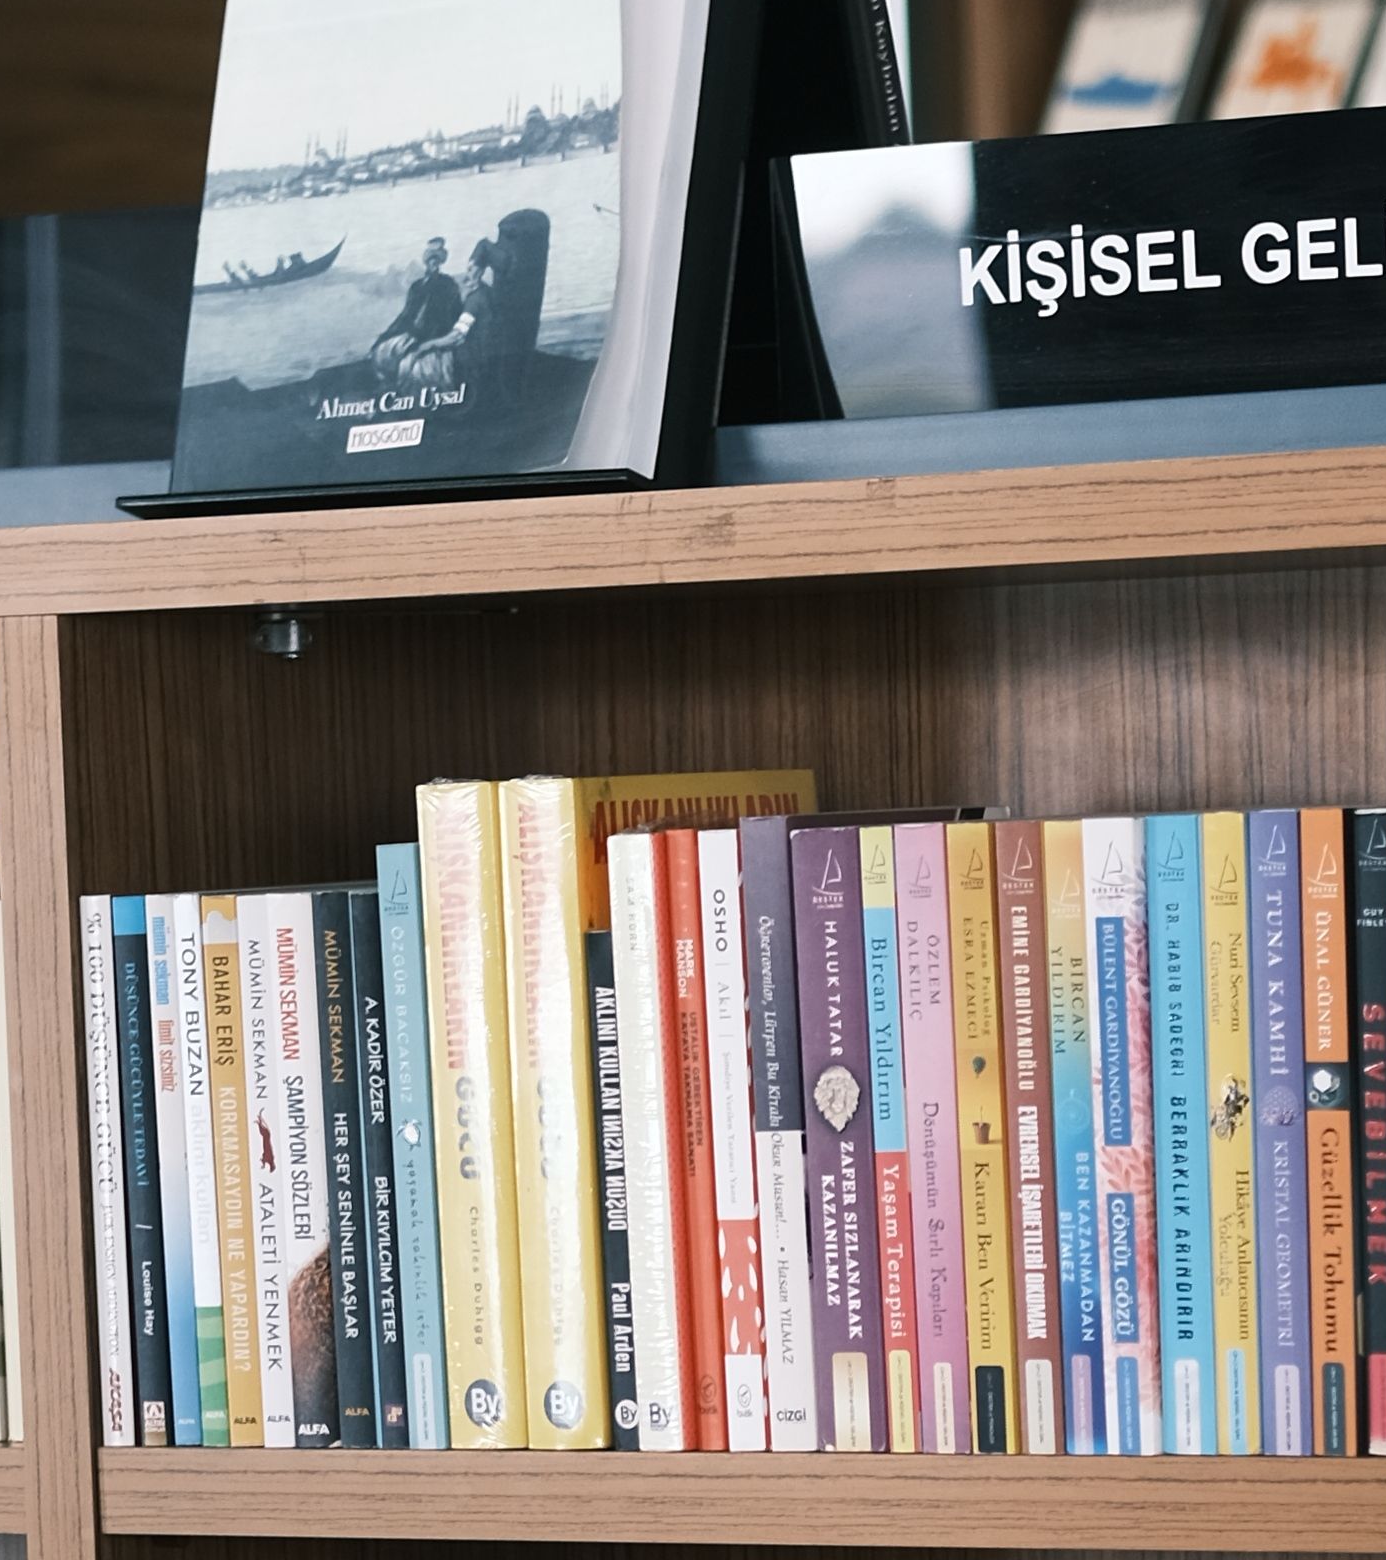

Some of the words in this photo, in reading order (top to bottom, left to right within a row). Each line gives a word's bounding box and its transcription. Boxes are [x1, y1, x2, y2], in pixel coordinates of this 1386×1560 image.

[960, 214, 1220, 319] KİŞİSEL
[316, 393, 375, 420] Ahmet
[379, 389, 414, 414] Can
[420, 383, 466, 411] Uysal
[711, 888, 730, 952] OSHO
[1010, 906, 1030, 959] EMİNE
[1314, 910, 1334, 971] ÜNAL
[322, 929, 345, 997] MÜMİN
[326, 1003, 347, 1084] SEKMAN
[1012, 964, 1037, 1090] GARDİYANOĞLU
[1315, 977, 1336, 1052] GÜNER
[596, 1046, 623, 1110] KULLAN
[331, 1112, 351, 1148] HER
[1016, 1105, 1039, 1181] EVRENSEL
[333, 1153, 353, 1185] ŞEY
[1319, 1127, 1342, 1236] Güzellik
[335, 1191, 357, 1264] SENİNLE
[1019, 1184, 1044, 1271] İŞARETLERİ
[338, 1270, 361, 1339] BAŞLAR
[611, 1282, 631, 1318] Paul
[1022, 1274, 1047, 1339] OKUMAK
[1321, 1247, 1343, 1354] Tohumu
[613, 1324, 633, 1372] Arden
